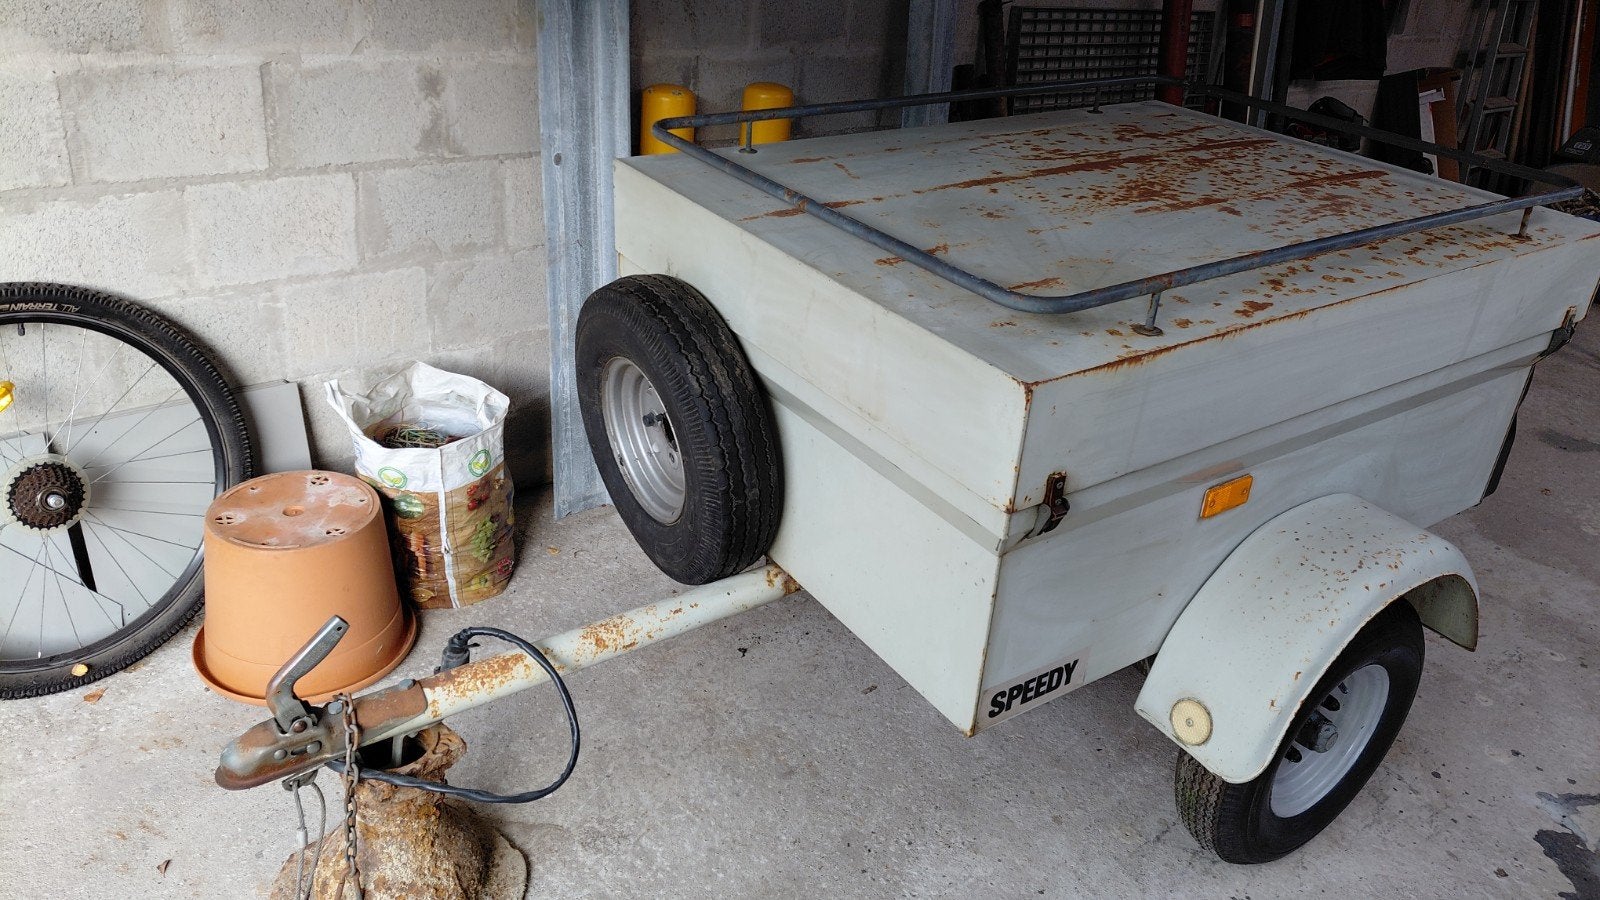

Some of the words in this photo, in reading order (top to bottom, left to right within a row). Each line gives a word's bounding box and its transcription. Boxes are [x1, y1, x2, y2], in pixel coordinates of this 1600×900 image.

[9, 302, 58, 312] TERRAIN
[61, 303, 81, 313] ALL
[988, 658, 1080, 719] SPEEDY
